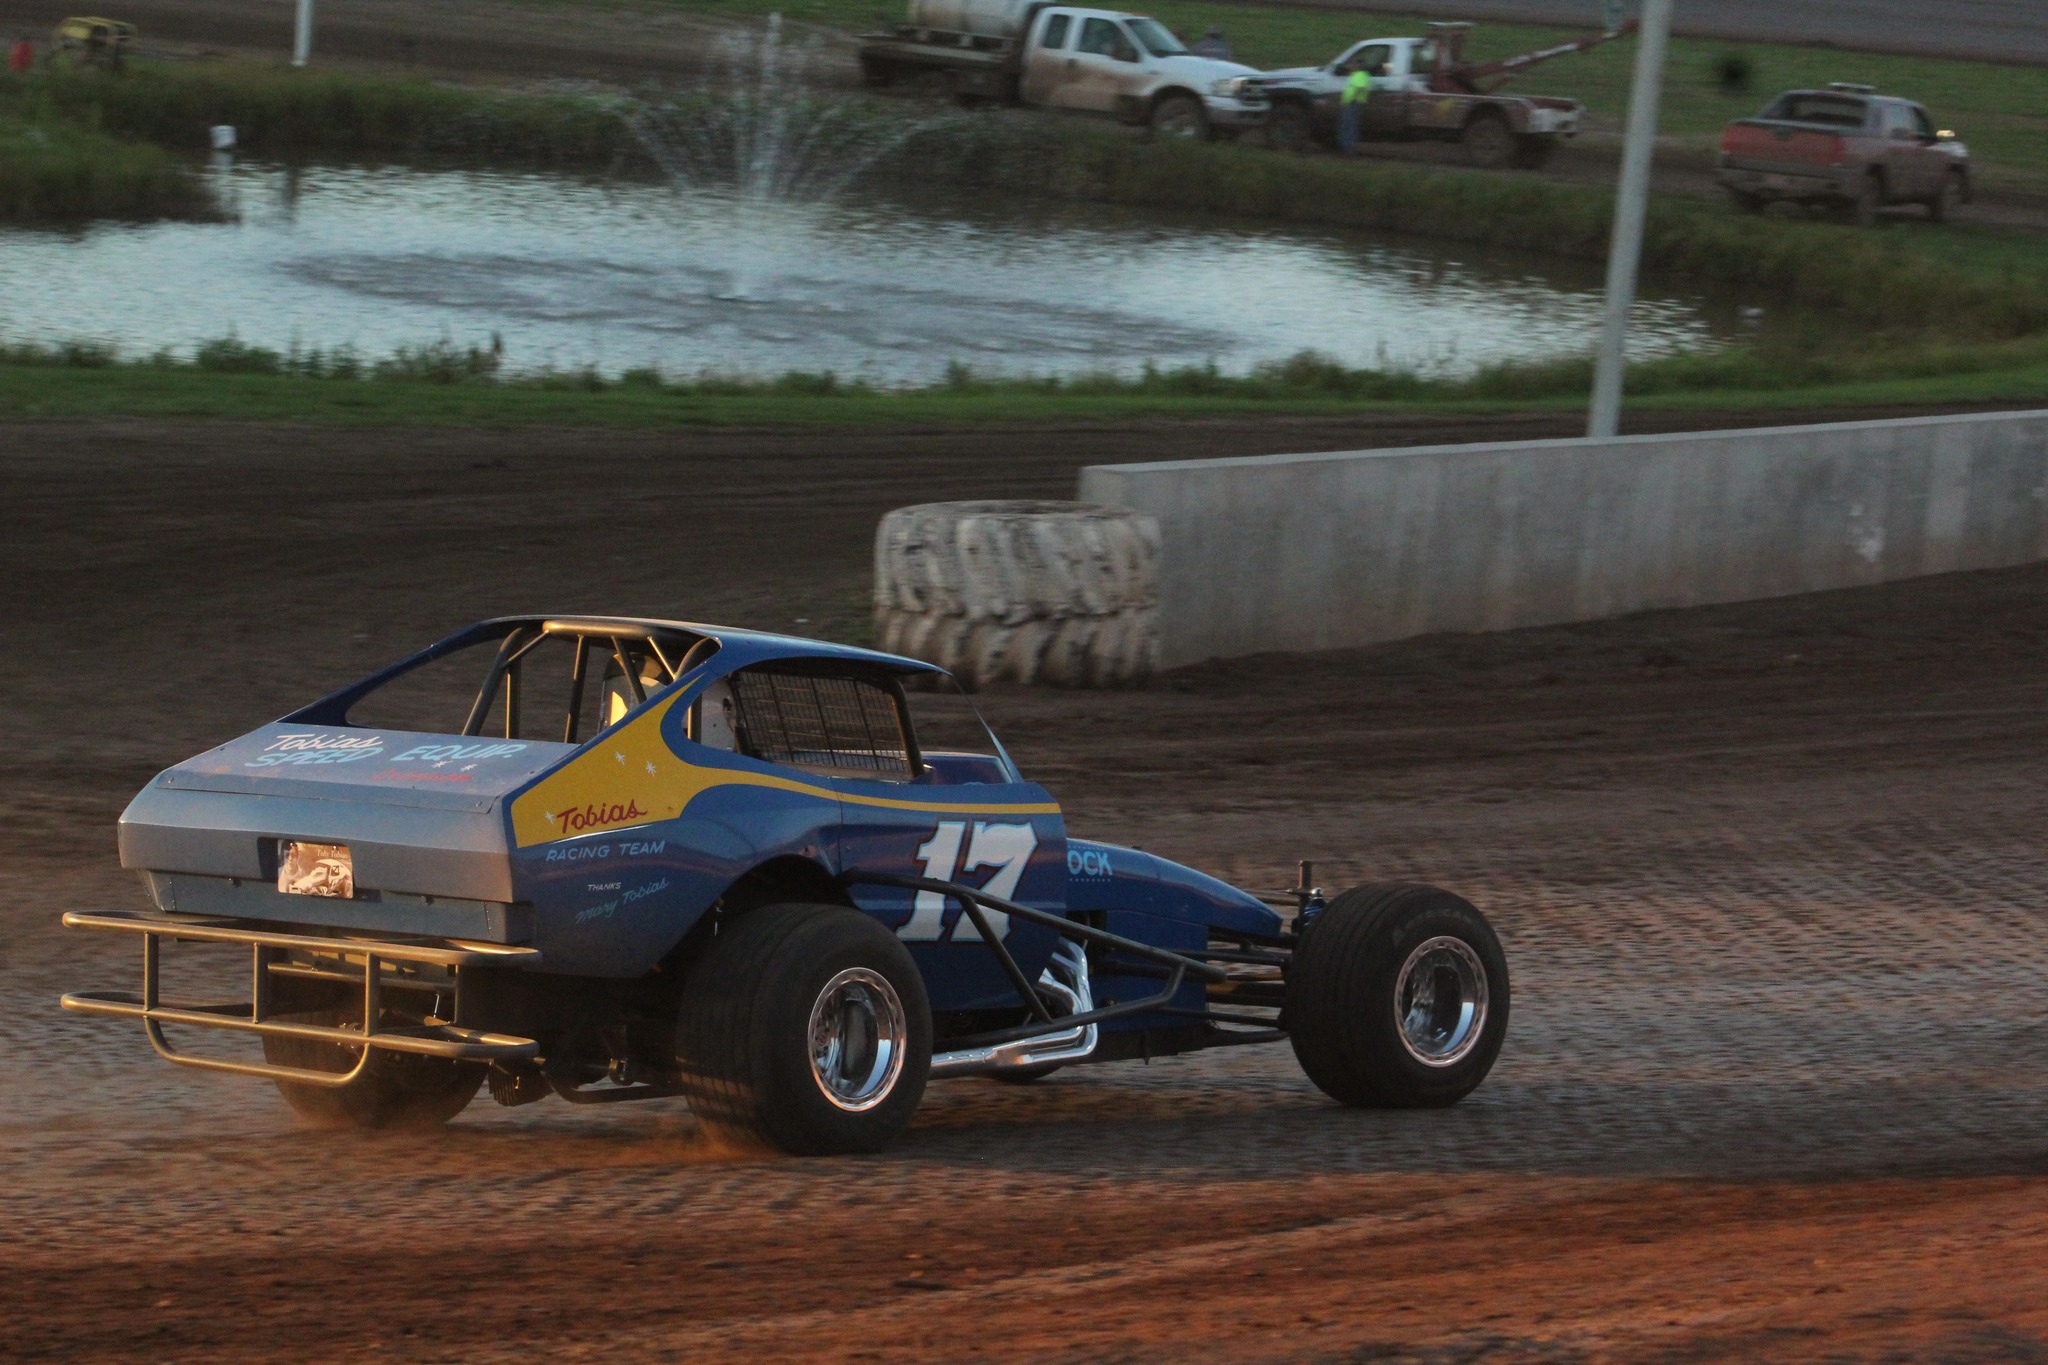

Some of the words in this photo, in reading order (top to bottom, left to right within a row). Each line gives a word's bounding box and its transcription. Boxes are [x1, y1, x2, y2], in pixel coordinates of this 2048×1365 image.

[264, 733, 383, 751] Tobias
[244, 747, 384, 767] SPEED
[556, 799, 648, 834] Tobias
[546, 845, 610, 862] RACING
[619, 840, 666, 856] TEAM
[587, 881, 622, 892] THANKS
[896, 820, 1038, 942] 17
